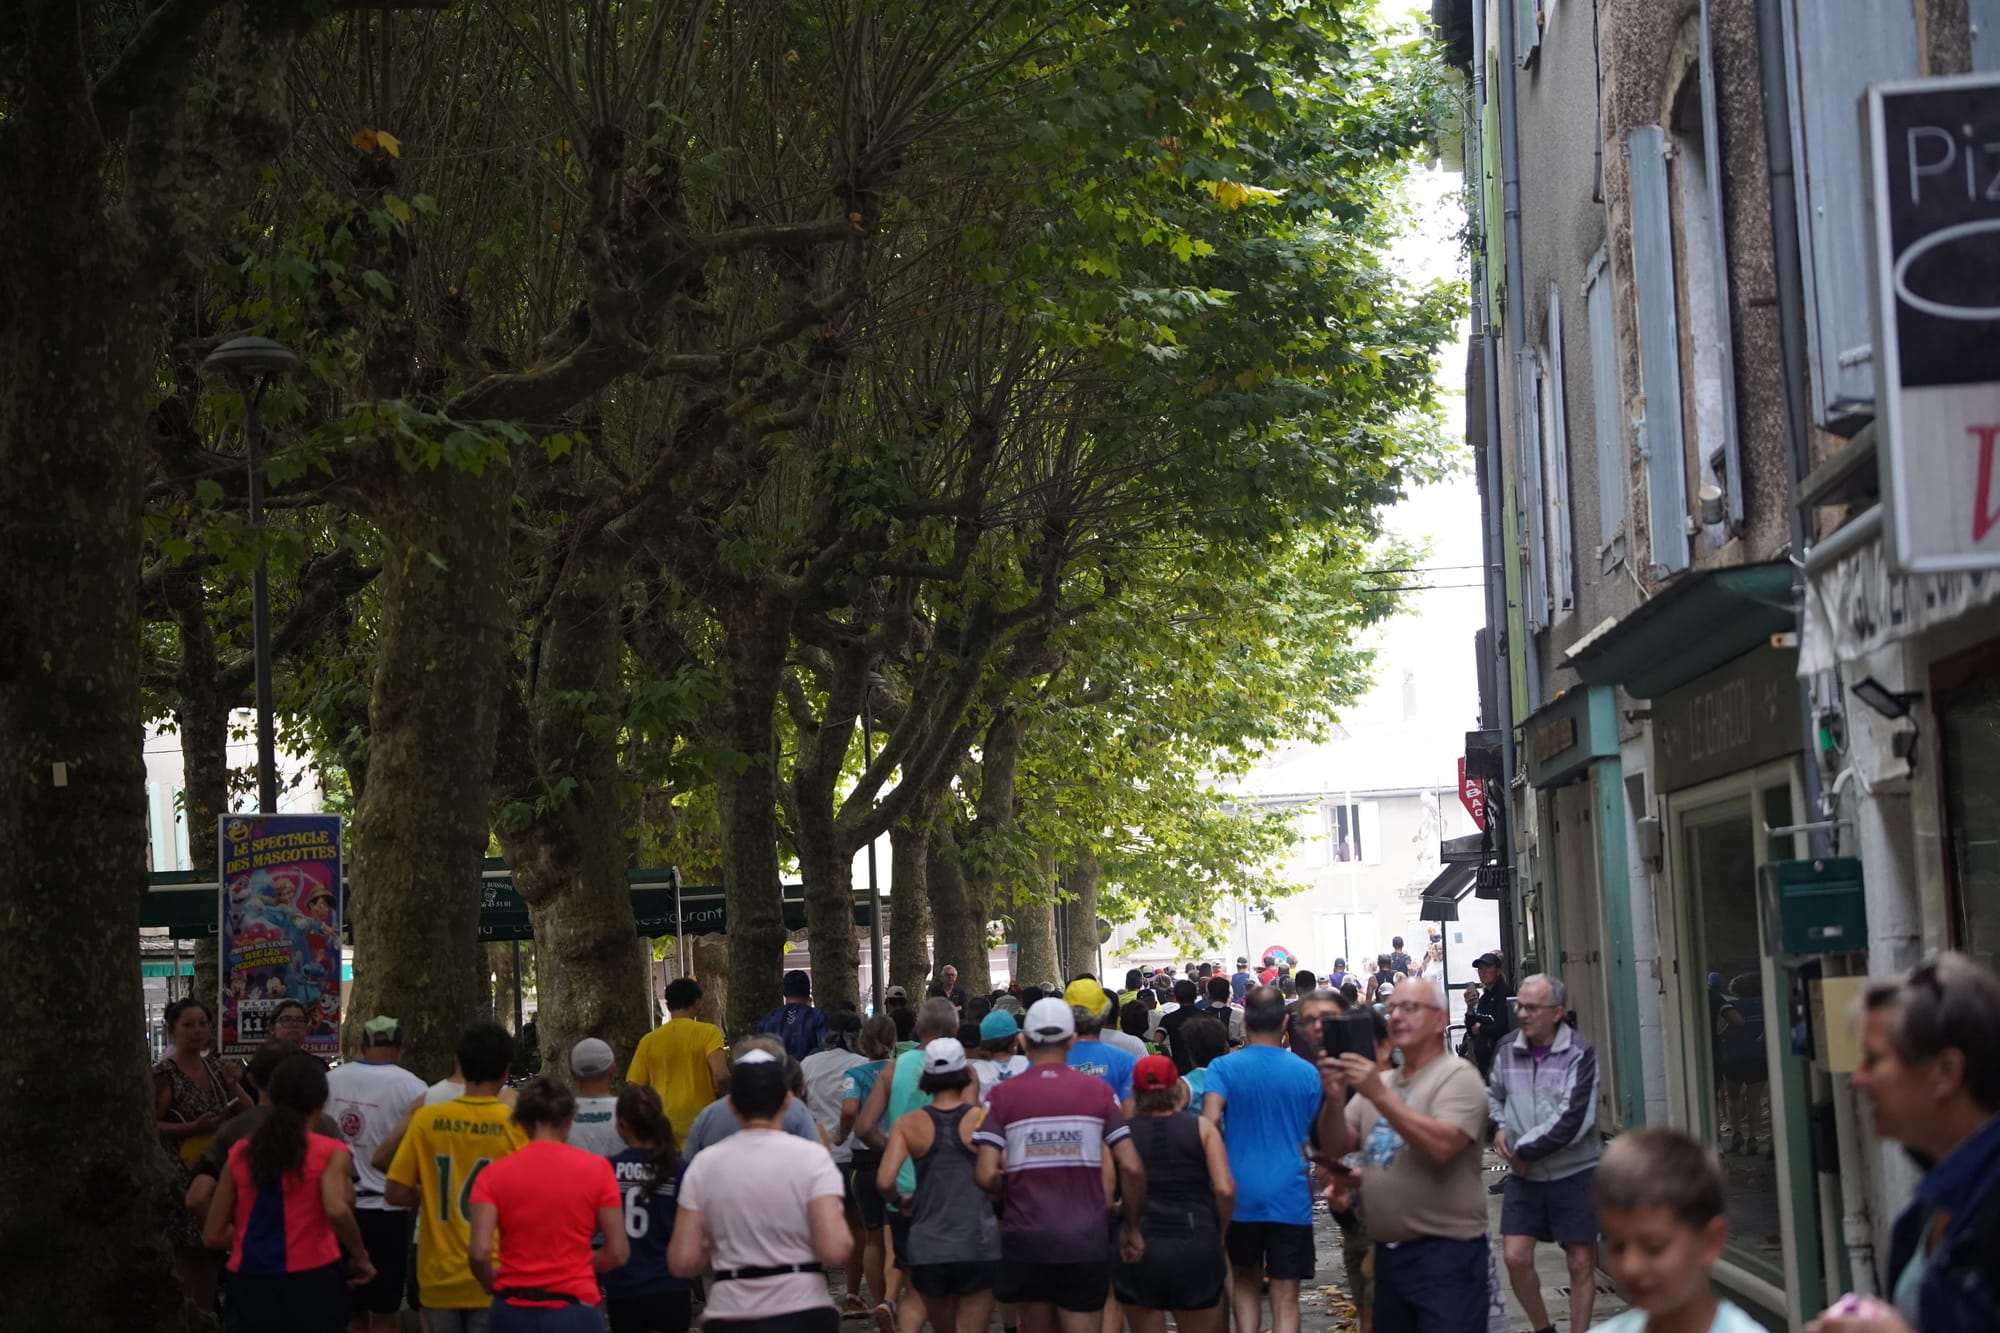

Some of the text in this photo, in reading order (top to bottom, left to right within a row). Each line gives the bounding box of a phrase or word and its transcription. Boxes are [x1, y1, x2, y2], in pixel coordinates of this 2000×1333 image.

[1464, 777, 1484, 817] ABAC
[233, 831, 329, 857] LE SPECTACLE
[226, 846, 337, 874] DES MASCOTTES
[243, 1018, 263, 1032] 11
[625, 1185, 649, 1239] 6
